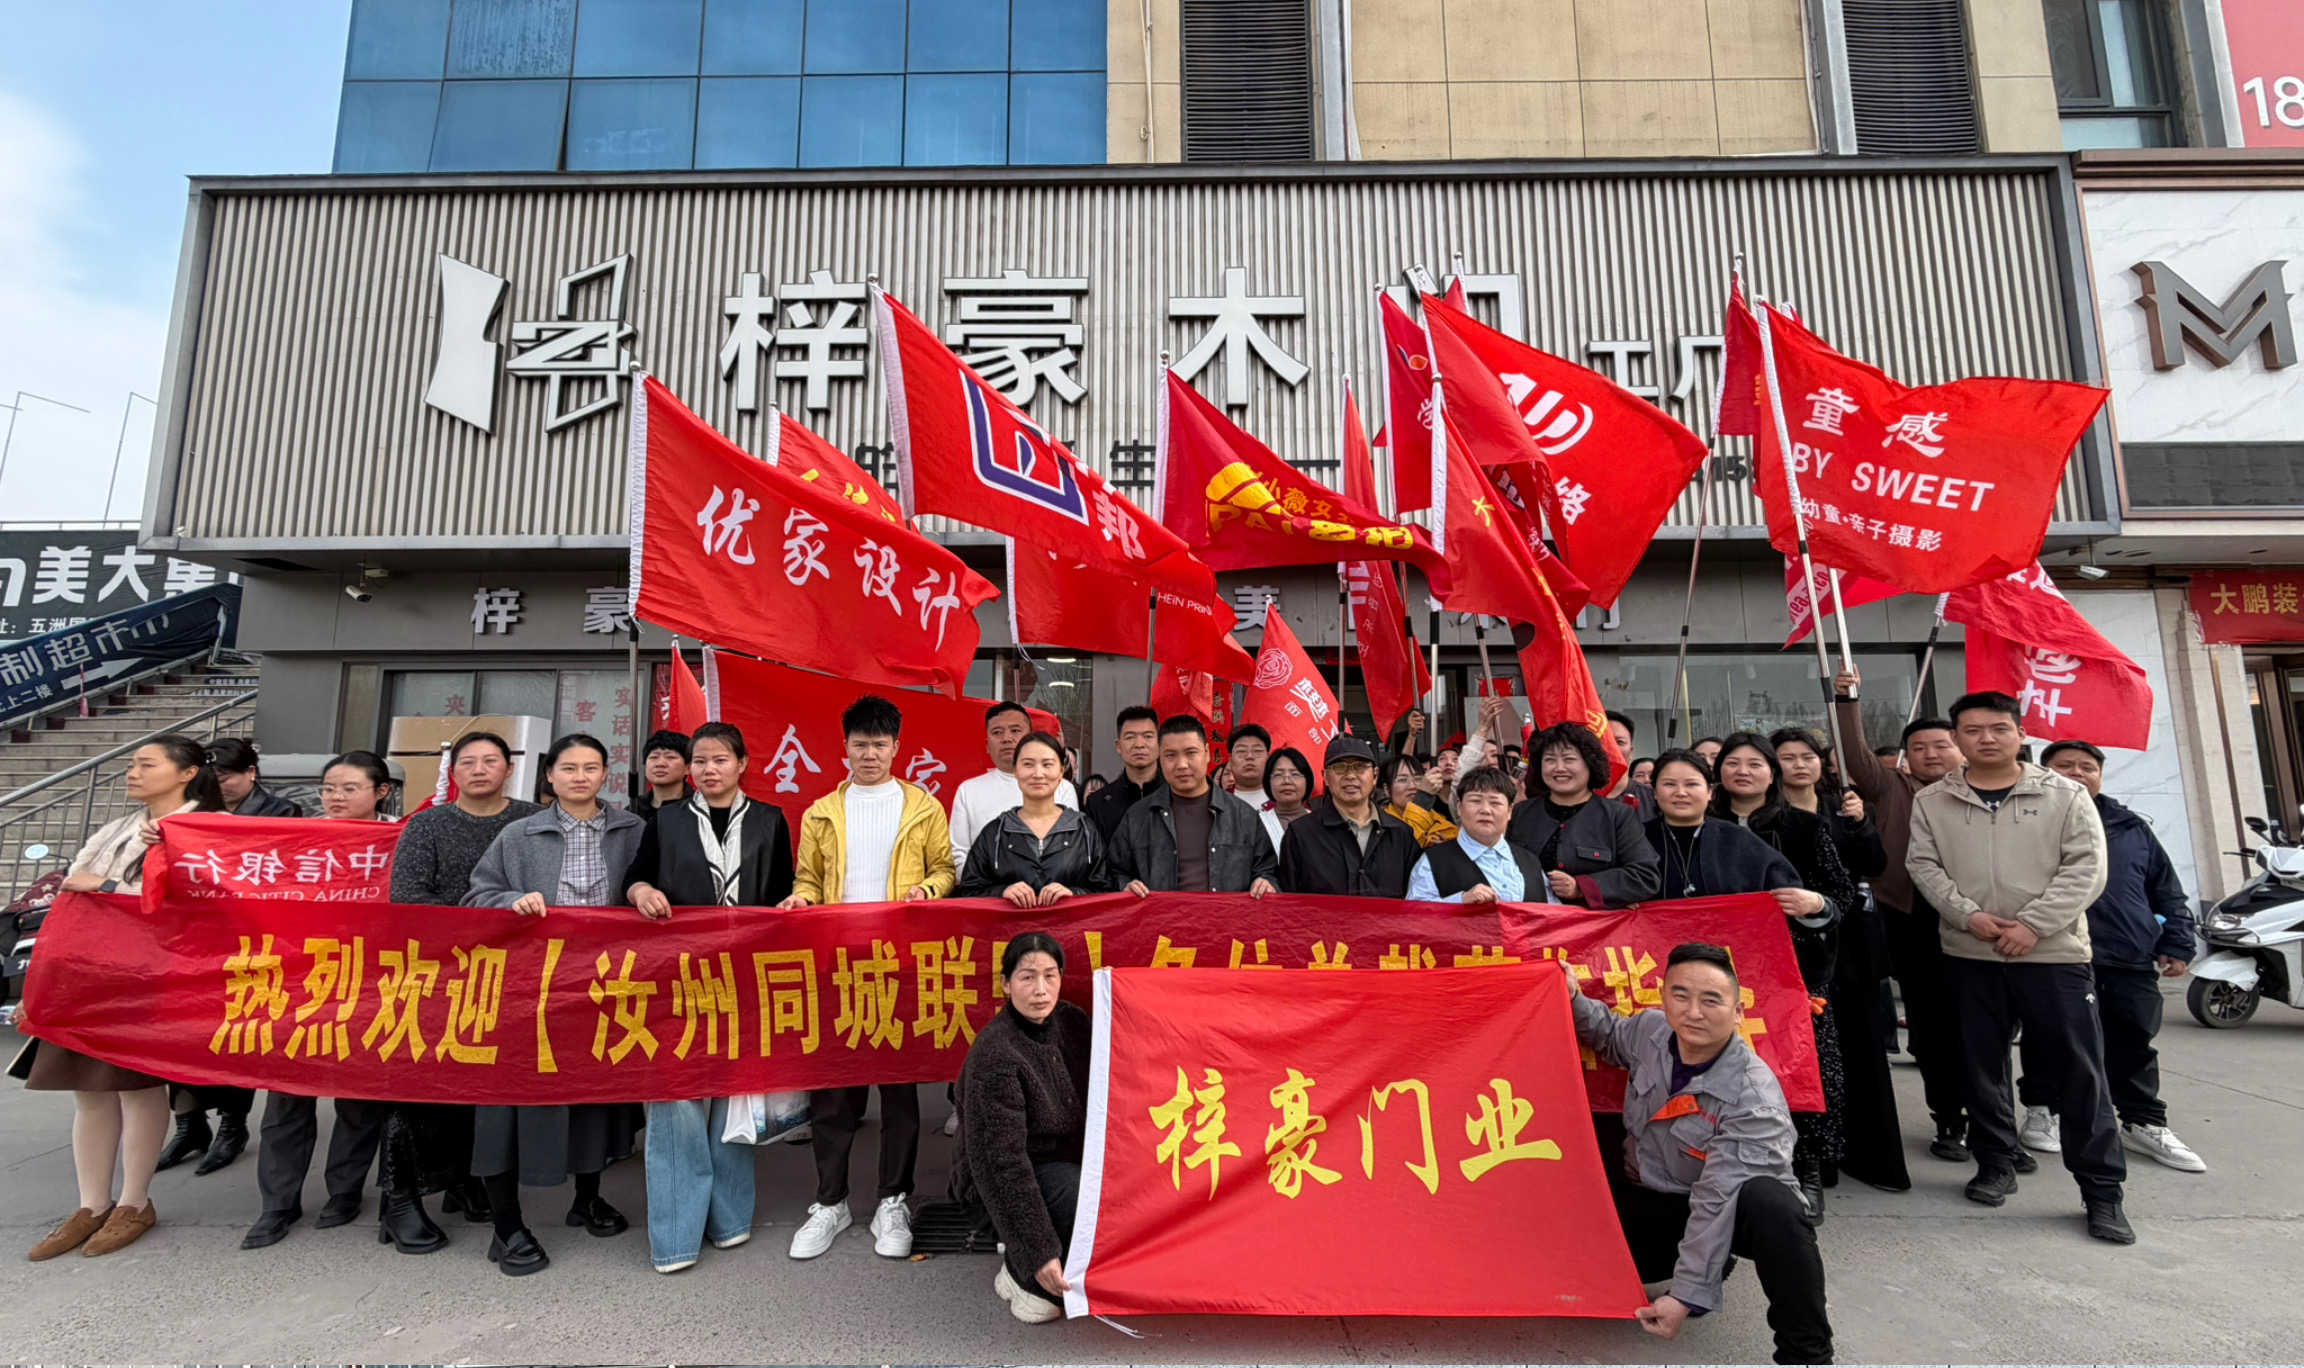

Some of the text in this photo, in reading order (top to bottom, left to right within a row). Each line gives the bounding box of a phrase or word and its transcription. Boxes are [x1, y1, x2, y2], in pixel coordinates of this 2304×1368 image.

[1803, 387, 1949, 458] 童感
[1851, 461, 1995, 512] SWEET
[696, 485, 961, 652] 优家设计
[1148, 1065, 1564, 1200] 梓豪门业
